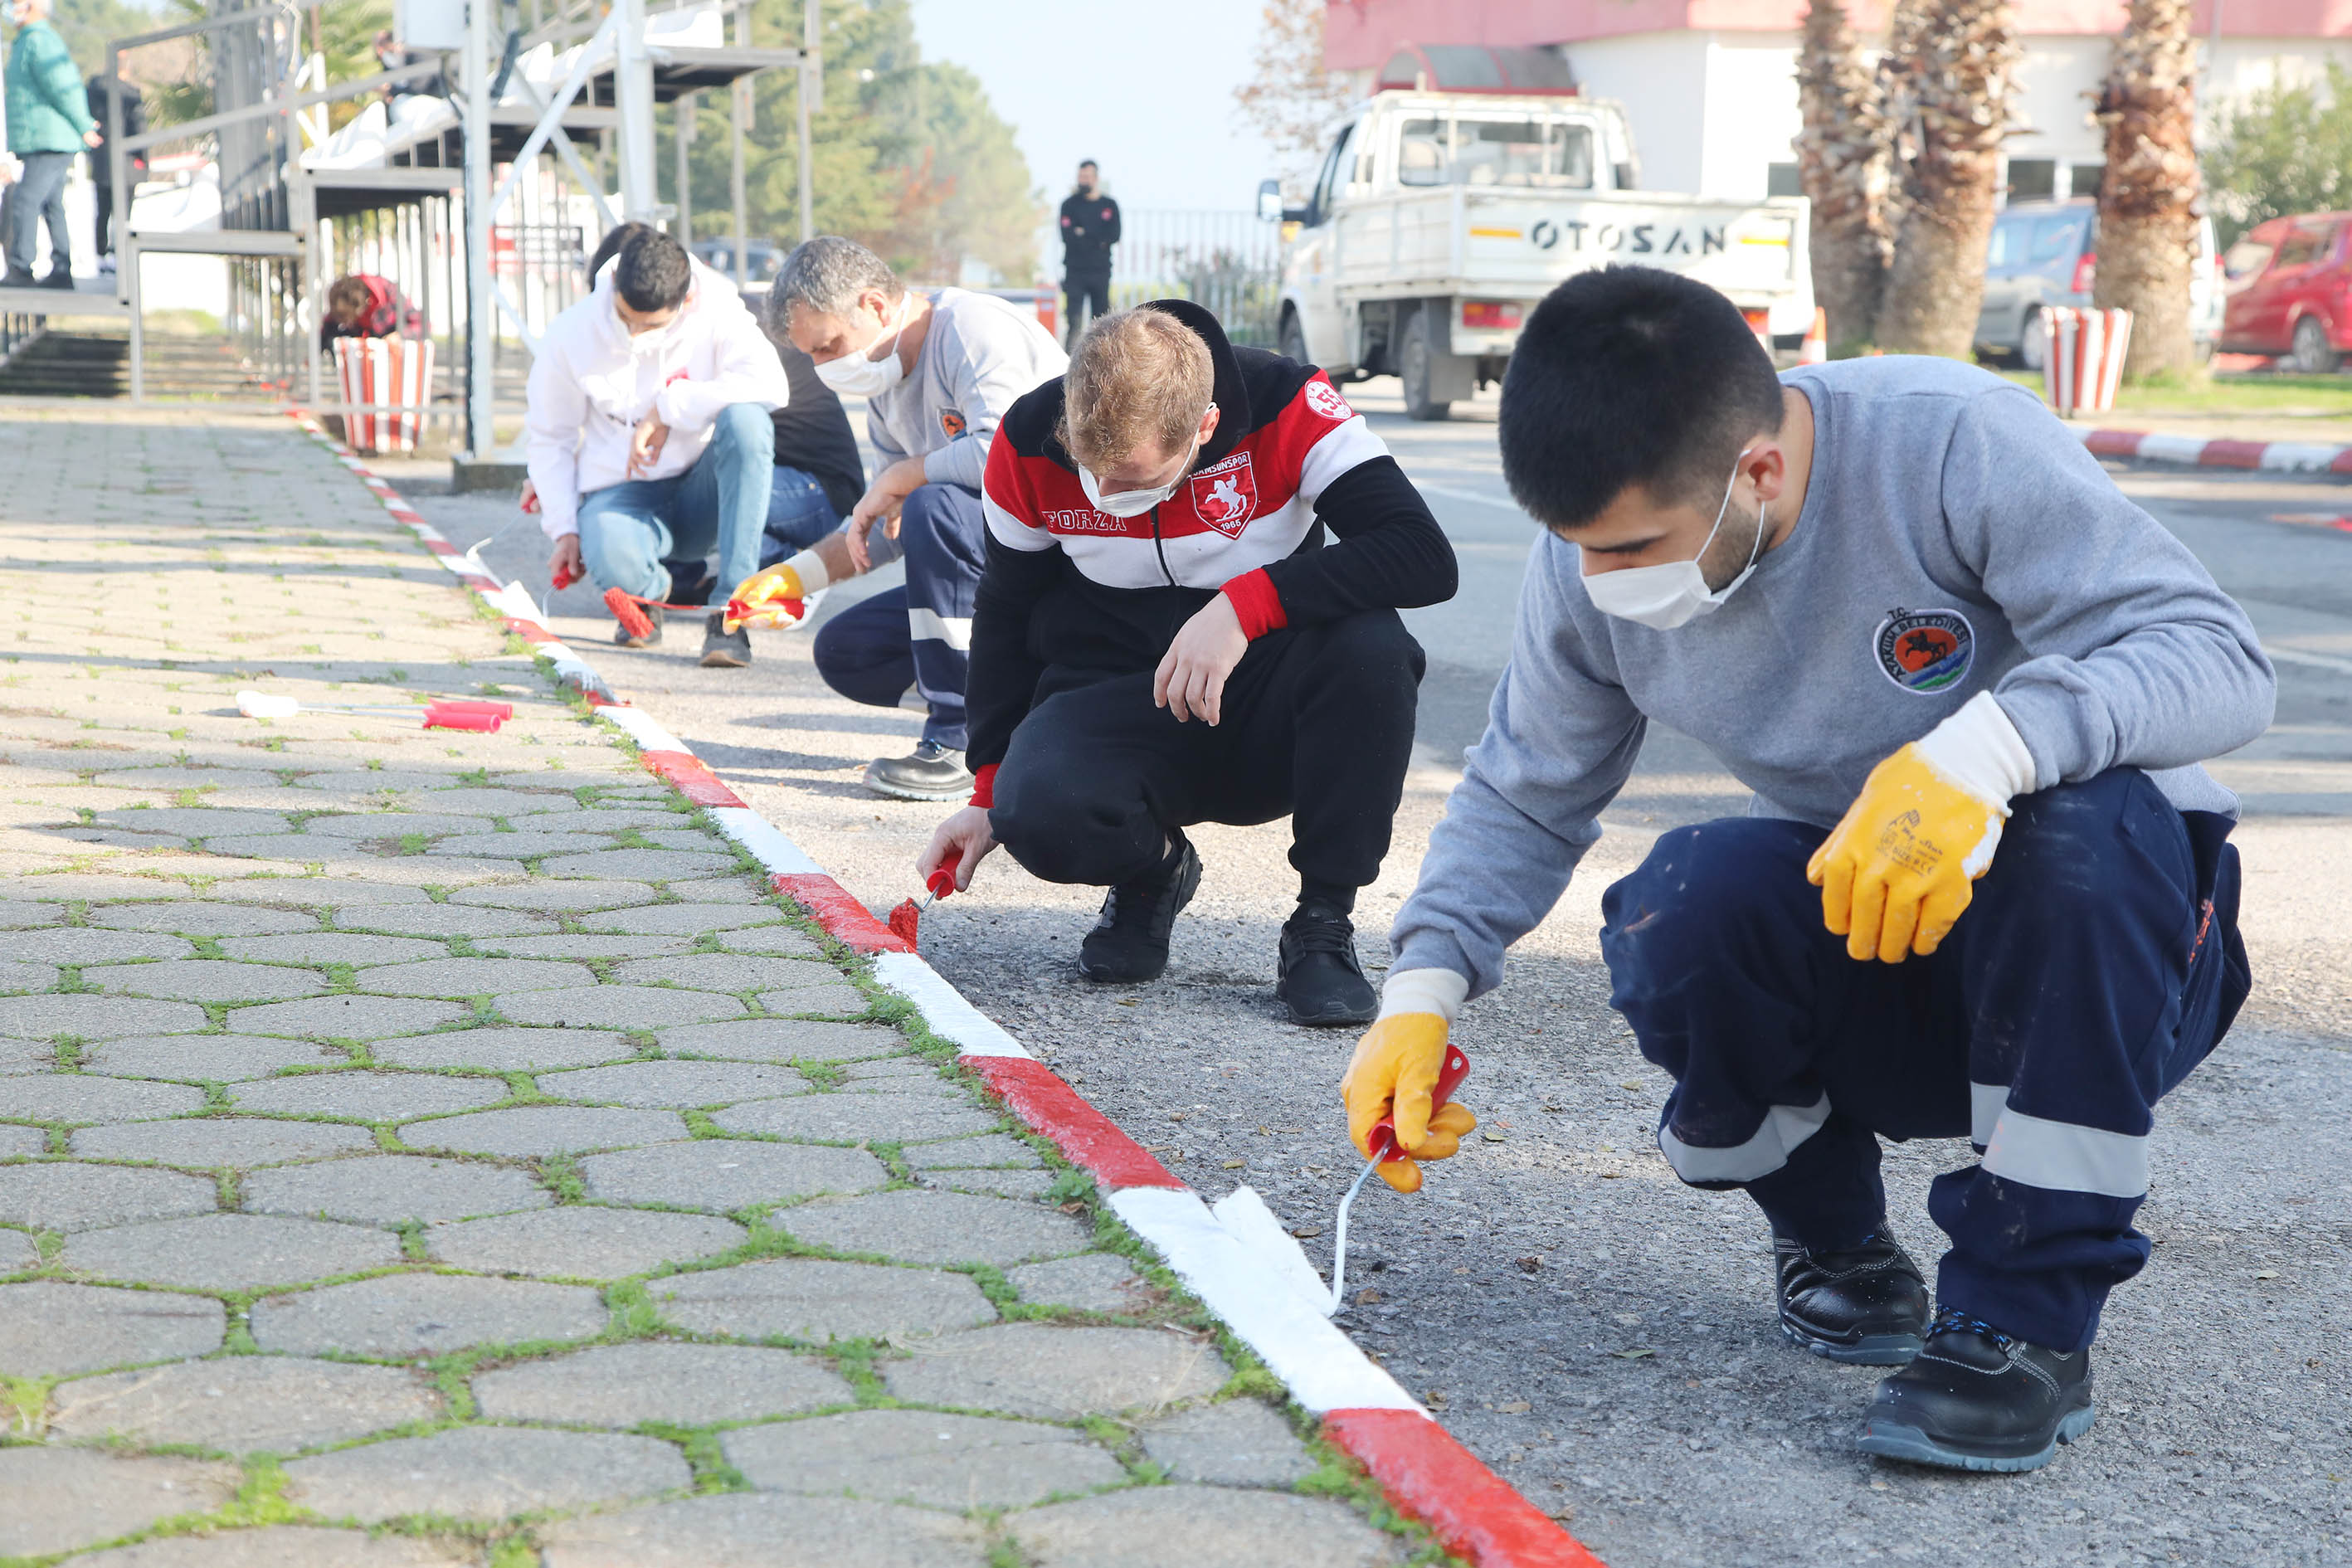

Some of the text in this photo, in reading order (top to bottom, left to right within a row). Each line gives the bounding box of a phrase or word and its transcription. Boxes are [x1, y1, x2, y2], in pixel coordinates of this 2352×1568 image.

[1532, 221, 1725, 254] OTOSAN
[1317, 388, 1342, 411] 55
[1041, 509, 1127, 531] FORZA
[1220, 519, 1242, 531] 1965
